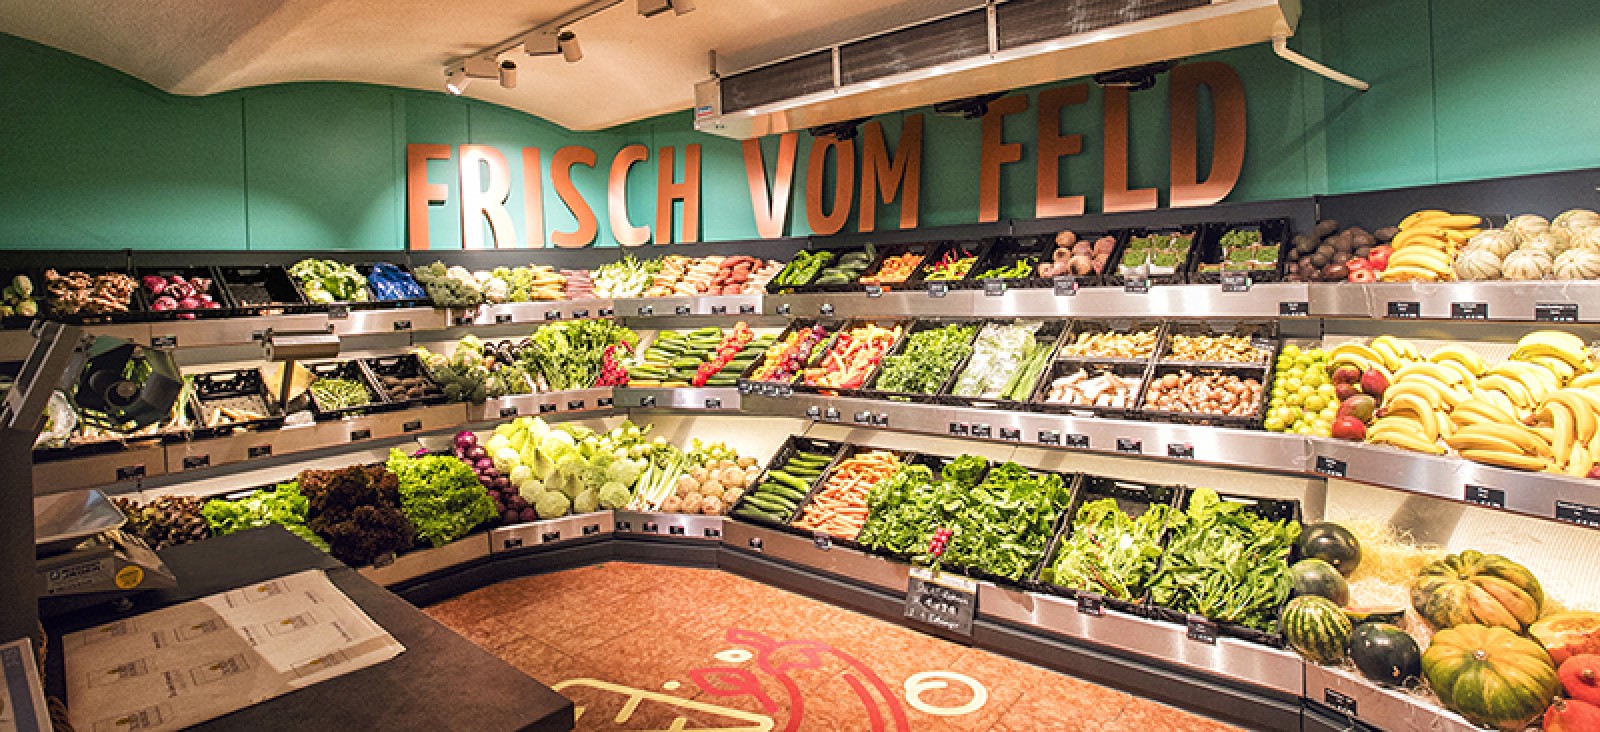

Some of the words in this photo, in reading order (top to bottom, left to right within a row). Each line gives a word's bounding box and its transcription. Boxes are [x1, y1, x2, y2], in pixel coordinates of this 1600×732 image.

[407, 143, 700, 250] FRISCH
[742, 114, 923, 238] VOM
[978, 62, 1246, 222] FELD
